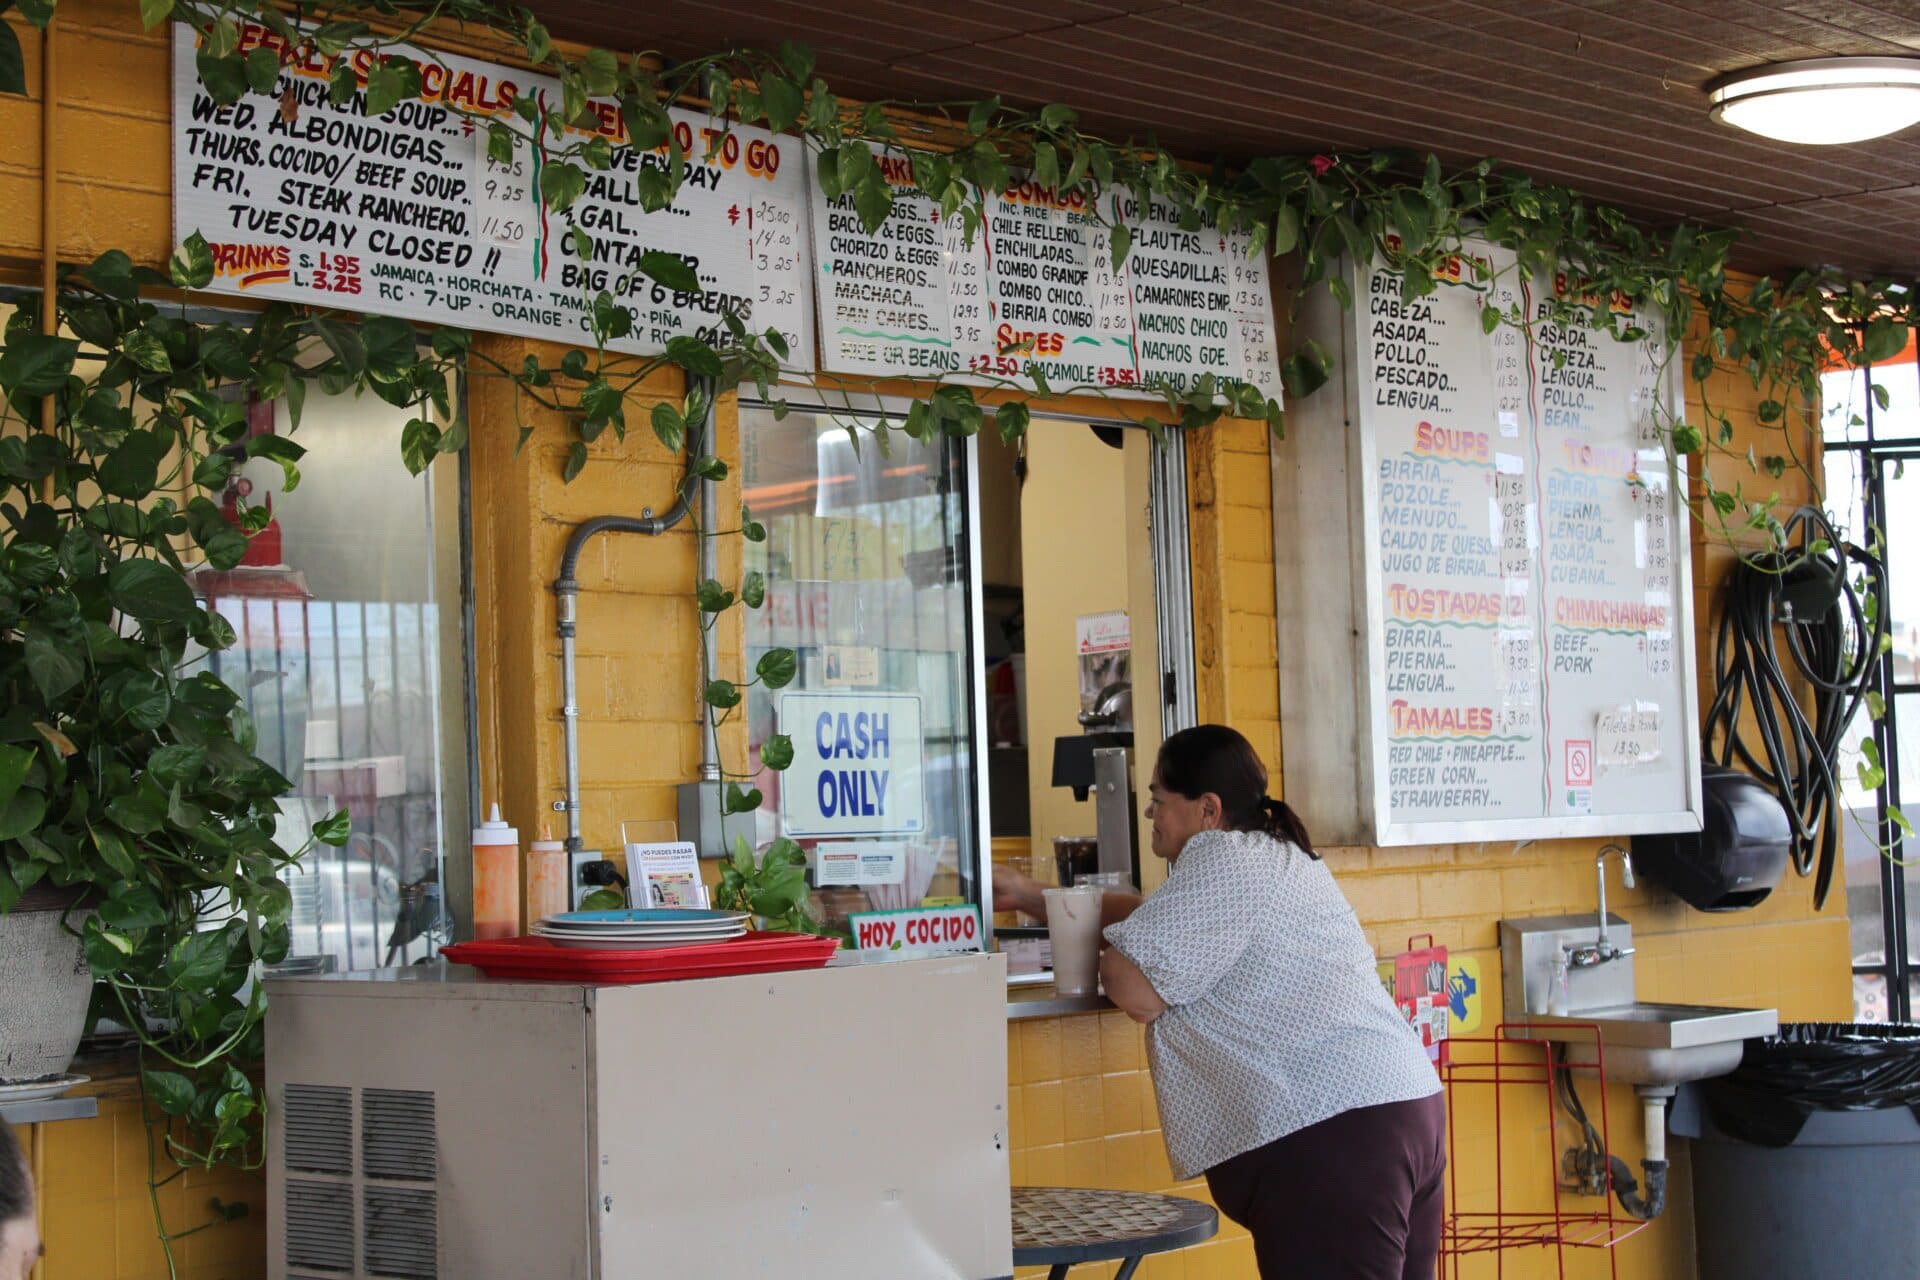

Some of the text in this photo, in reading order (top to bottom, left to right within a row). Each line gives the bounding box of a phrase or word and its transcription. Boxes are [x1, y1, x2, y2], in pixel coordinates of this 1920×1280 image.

[351, 48, 518, 118] SCIALS
[192, 94, 257, 131] WED.
[186, 128, 265, 168] THURS.
[355, 160, 406, 191] BEEF
[747, 138, 780, 181] GO
[192, 163, 251, 198] FRI.
[278, 178, 352, 215] STEAK
[485, 180, 524, 201] 9.25
[580, 205, 638, 237] GAL.
[755, 201, 790, 224] 25.00
[1023, 206, 1048, 219] RICE
[229, 205, 357, 249] TUESDAY
[368, 229, 472, 268] CLOSED
[482, 217, 524, 240] 11.50
[755, 229, 792, 247] 14.00
[883, 223, 893, 239] &
[992, 217, 1022, 236] CHILE
[831, 236, 888, 260] CHORIZO
[895, 246, 904, 262] &
[319, 252, 360, 274] 1.95
[756, 254, 794, 272] 3.25
[997, 260, 1037, 279] COMBO
[312, 270, 362, 294] 3.25
[562, 264, 753, 322] BAG OF 6 BREADS
[1000, 281, 1041, 301] COMBO
[370, 263, 682, 328] JAMAICA HORCHATA PIÑA
[379, 282, 403, 301] RC
[424, 289, 472, 311] 7-UP
[492, 302, 562, 327] ORANGE
[758, 286, 797, 306] 3.25
[1135, 284, 1205, 308] CAMARONES
[1002, 303, 1092, 328] BIRRIA COMBO
[1139, 311, 1228, 339] NACHOS CHICO
[909, 348, 960, 371] BEANS
[1142, 340, 1229, 366] NACHOS GDE.
[1415, 421, 1489, 457] SOUPS
[1381, 528, 1427, 550] CALDO
[1431, 533, 1448, 553] DE
[1382, 553, 1422, 573] JUGO
[1426, 558, 1441, 574] DE
[1389, 583, 1501, 619] TOSTADAS
[1554, 655, 1593, 673] PORK
[1390, 699, 1493, 735] TAMALES
[815, 711, 890, 760] CASH
[1389, 745, 1412, 763] RED
[1416, 746, 1443, 763] CHILE
[1390, 768, 1435, 786] GREEN
[817, 770, 889, 819] ONLY
[859, 914, 975, 950] HOY COCIDO
